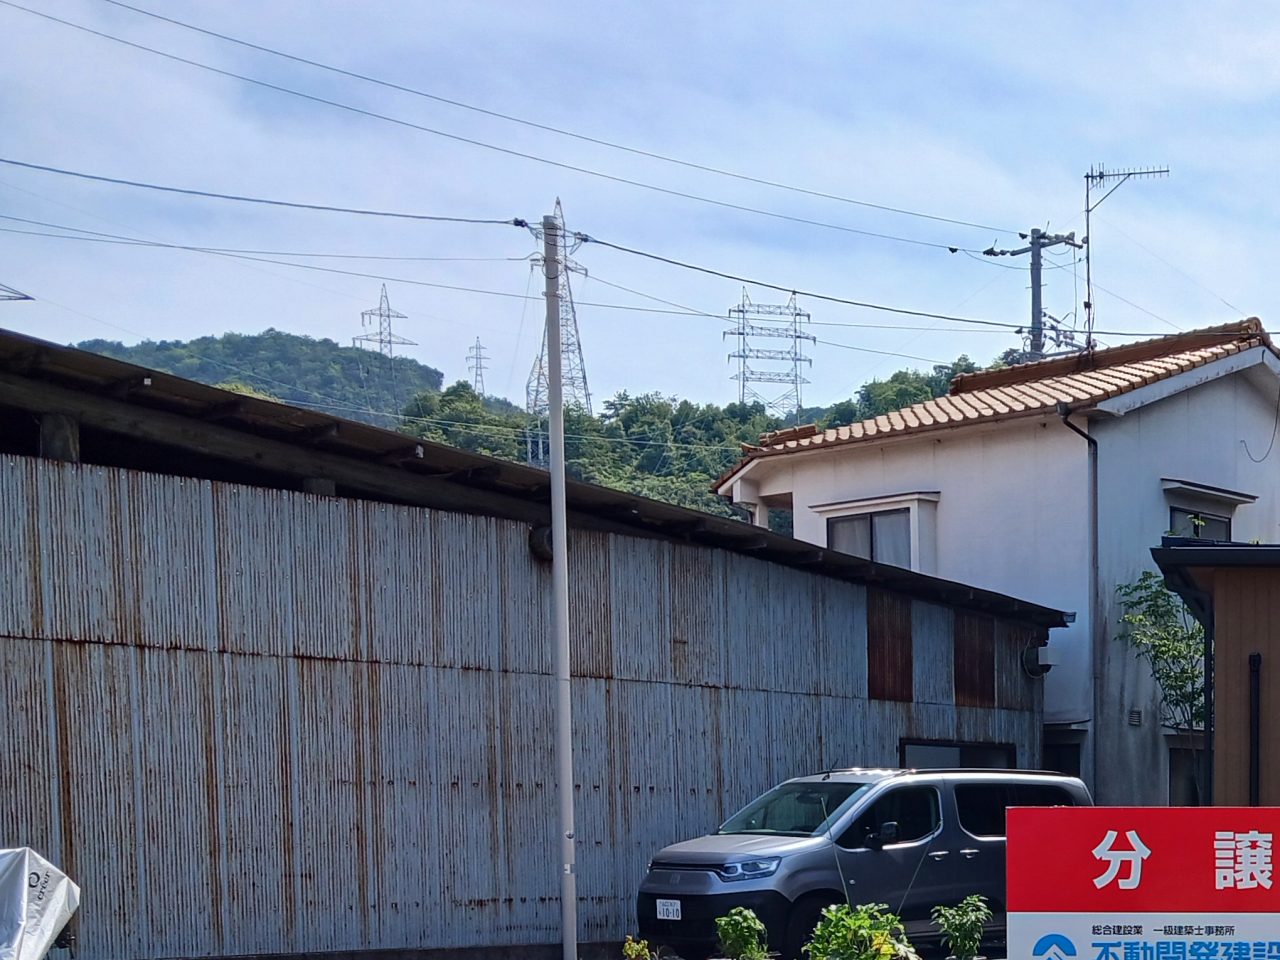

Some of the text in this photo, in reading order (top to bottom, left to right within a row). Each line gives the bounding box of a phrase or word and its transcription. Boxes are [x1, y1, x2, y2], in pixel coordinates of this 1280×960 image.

[1091, 925, 1235, 936] 総合建設業 一級建築士事務所
